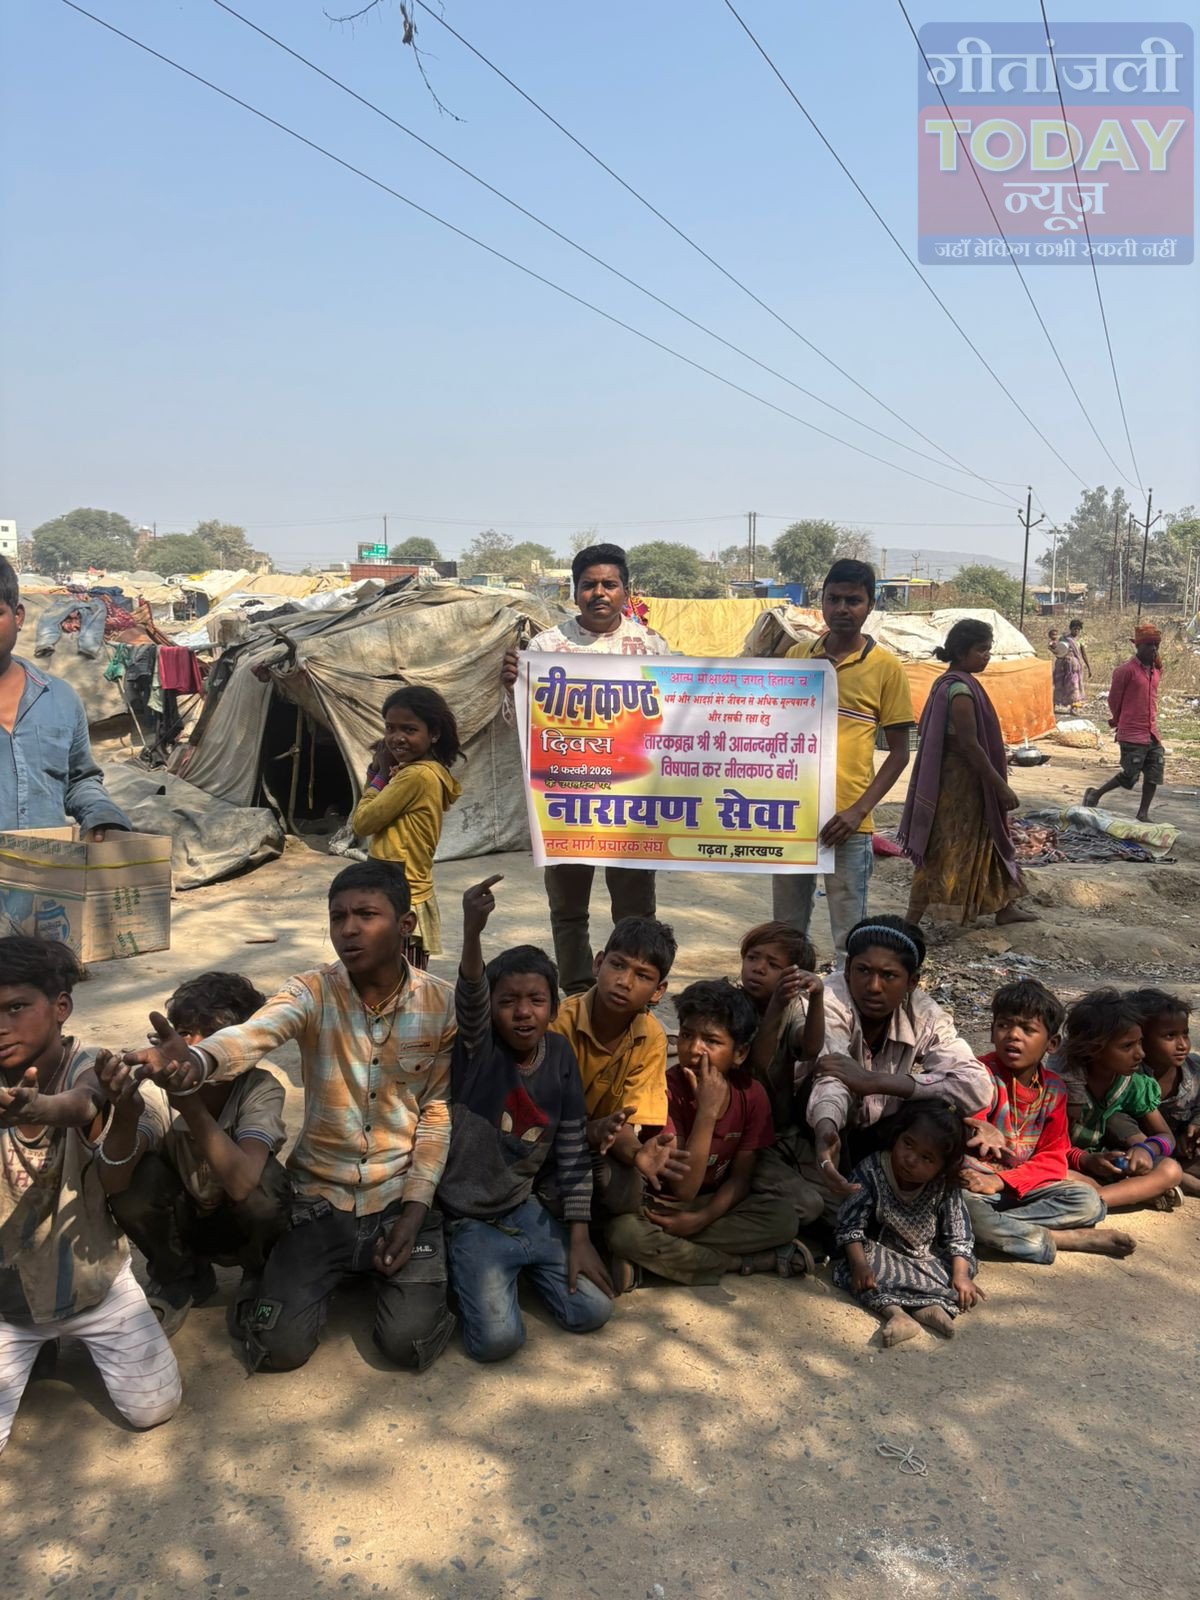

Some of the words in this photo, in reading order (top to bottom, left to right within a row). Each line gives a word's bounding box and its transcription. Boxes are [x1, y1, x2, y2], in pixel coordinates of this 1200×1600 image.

[678, 691, 691, 704] और
[748, 693, 754, 706] से
[757, 694, 779, 706] अधिक
[810, 694, 817, 707] है
[707, 709, 722, 722] और
[723, 710, 743, 722] इसकी
[745, 711, 758, 723] रक्षा
[759, 711, 772, 727] हेतु
[541, 728, 615, 756] दिवस
[697, 730, 710, 752] श्री
[713, 730, 726, 752] श्री
[791, 733, 806, 754] जी
[807, 734, 818, 754] ने
[549, 765, 559, 774] 12
[561, 764, 587, 775] फरवरी
[589, 766, 612, 775] 2026
[661, 755, 699, 777] विषपान
[702, 761, 722, 778] कर
[724, 757, 774, 779] नीलकण्ठ
[544, 793, 702, 829] नारायण
[715, 788, 800, 831] सेवा
[544, 838, 568, 851] नन्द
[572, 836, 595, 851] मार्ग
[597, 840, 640, 852] प्रचारक
[643, 838, 663, 853] संघ
